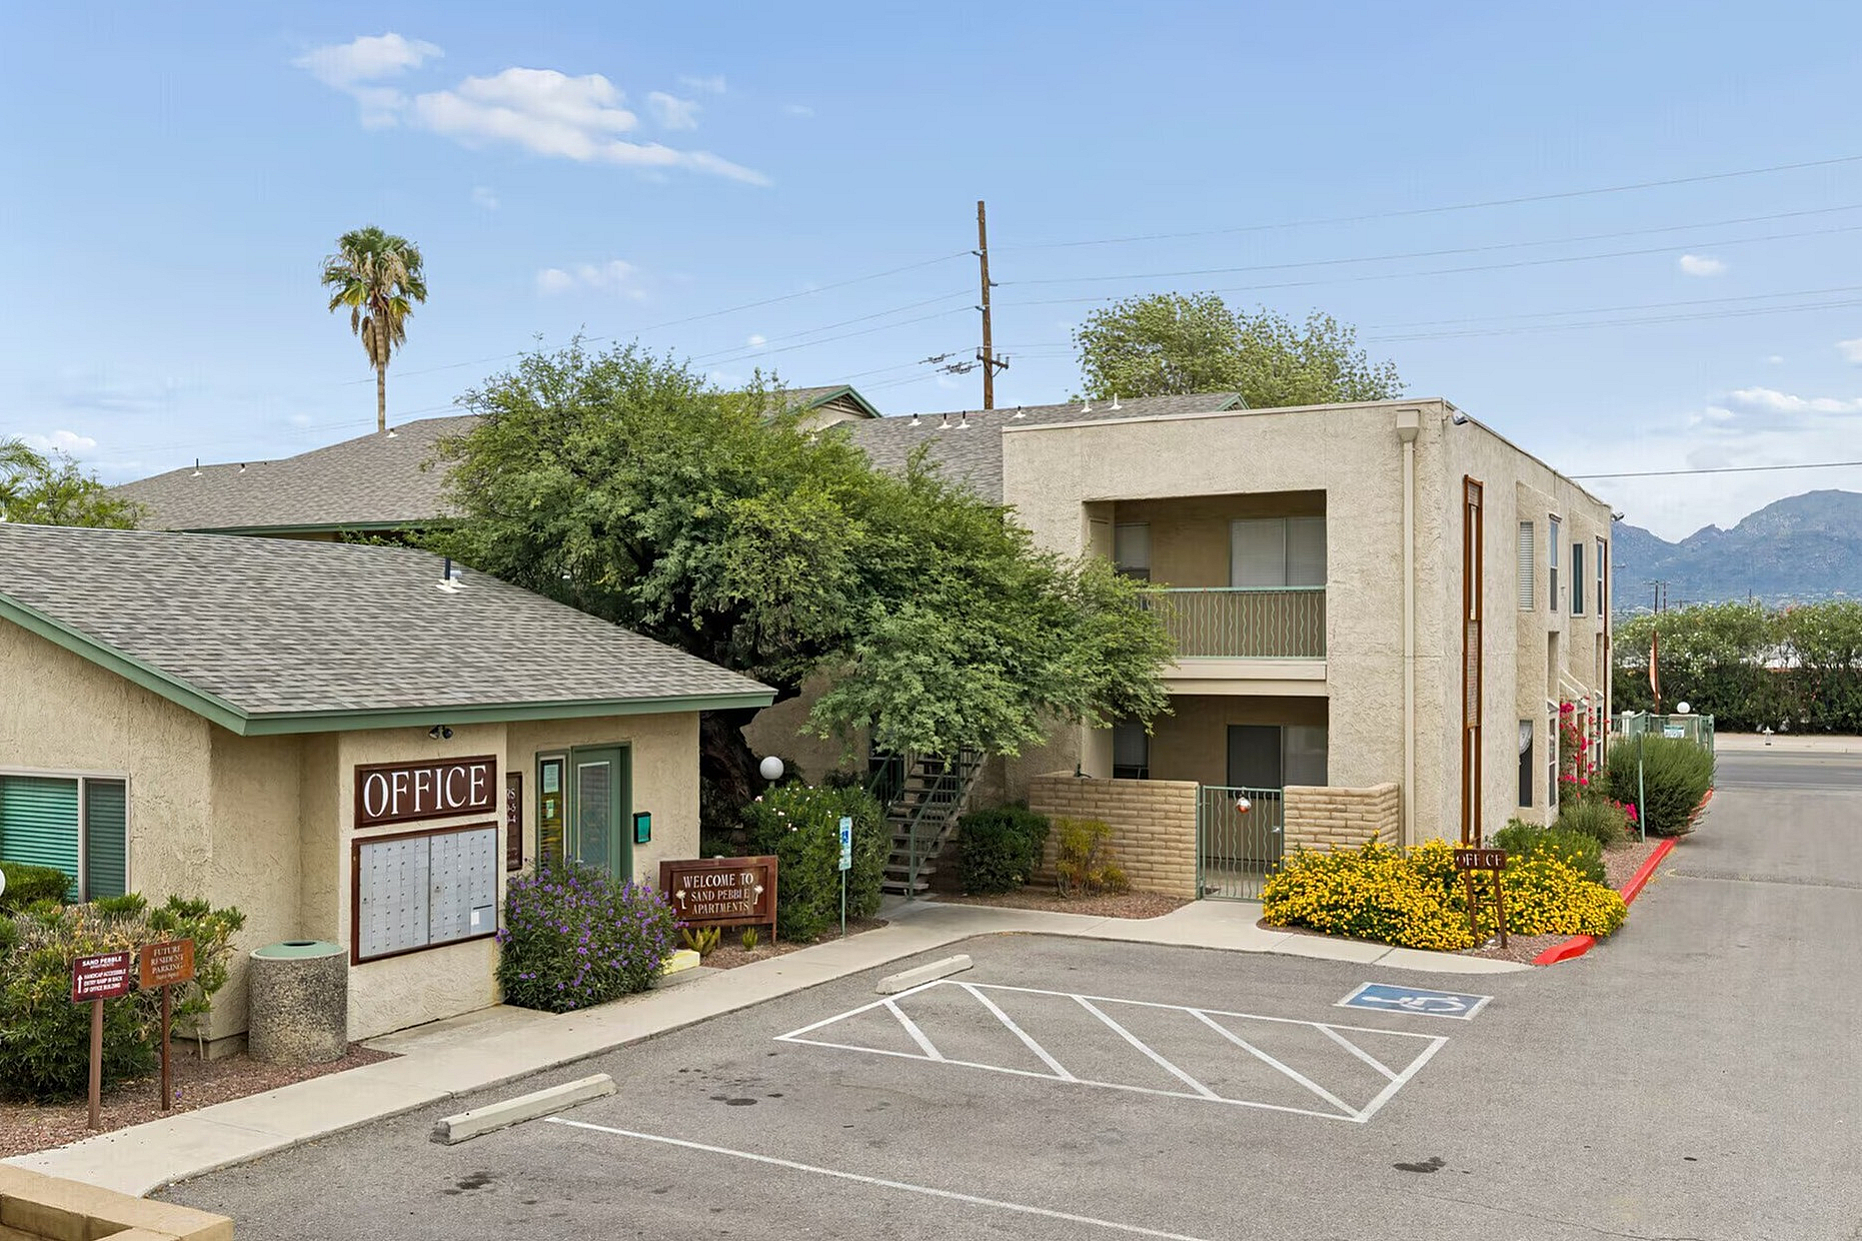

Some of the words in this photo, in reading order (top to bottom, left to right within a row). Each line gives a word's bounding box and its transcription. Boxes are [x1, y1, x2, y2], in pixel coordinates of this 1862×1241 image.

[363, 765, 488, 818] OFFICE
[1456, 853, 1502, 866] OFFICE
[683, 874, 736, 888] WELCOME
[740, 873, 754, 885] TO
[691, 890, 715, 902] SAND
[717, 889, 750, 900] PEBBLE
[692, 901, 749, 915] APARTMENTS
[153, 945, 182, 957] FUTURE
[82, 959, 99, 967] SAND
[100, 956, 122, 964] PEBBLE
[151, 954, 184, 966] RESIDENT
[152, 962, 183, 974] PARKING
